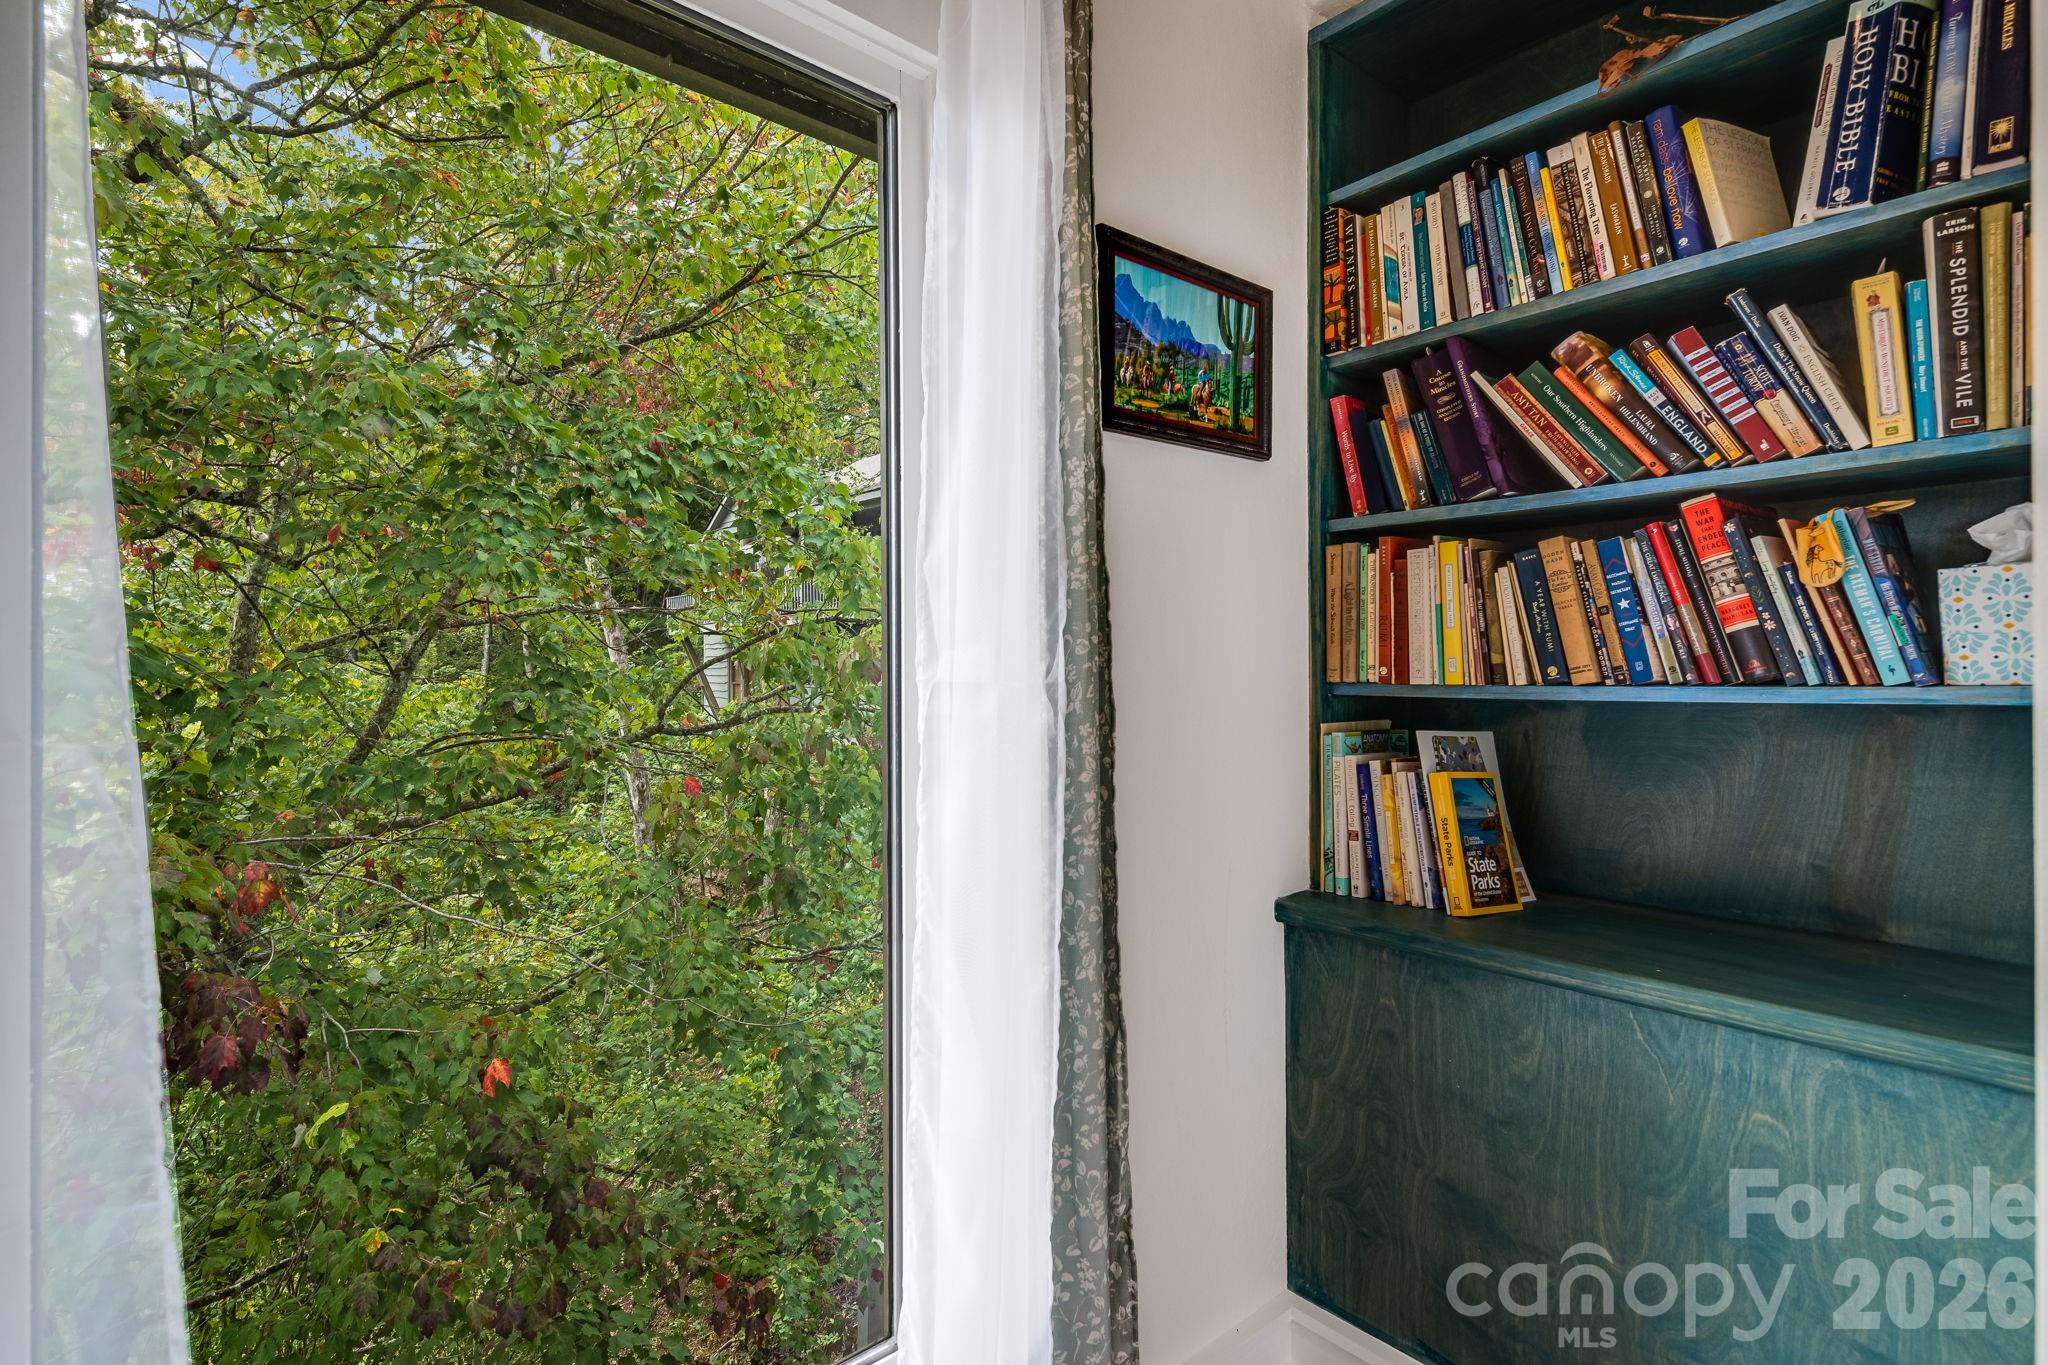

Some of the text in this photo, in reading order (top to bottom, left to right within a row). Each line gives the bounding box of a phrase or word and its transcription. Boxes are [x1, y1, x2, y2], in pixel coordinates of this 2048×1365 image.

[2002, 2, 2016, 50] MIRACLES
[1834, 25, 1879, 173] HOLY BIBLE
[1594, 137, 1605, 149] THE
[1651, 118, 1672, 163] ram dass
[1628, 136, 1645, 183] SACRED SOUL
[1633, 130, 1651, 182] SACRED EARTH
[1515, 176, 1530, 211] FINDING
[1579, 165, 1602, 235] The Flowering Tree
[1661, 166, 1686, 231] be love now
[1522, 212, 1535, 238] INNER
[1536, 201, 1547, 226] SEARCH
[1607, 202, 1624, 235] EASWARAN
[1649, 203, 1662, 239] JOHN PHILIP
[1945, 216, 1968, 228] ERIK
[1367, 229, 1377, 256] BHAGAVAD
[1542, 227, 1550, 241] FOR
[1936, 223, 1976, 237] LARSON
[1343, 224, 1356, 292] WITNESS
[1399, 245, 1407, 269] TERESA
[1527, 238, 1541, 275] COURAGE
[1545, 242, 1556, 272] MEANING
[1954, 240, 1963, 253] THE
[1401, 270, 1407, 278] OF
[1370, 279, 1379, 308] EASWARAN
[1401, 280, 1409, 300] AVILA
[1948, 257, 1969, 336] SPLENDID
[1958, 340, 1966, 356] AND
[1777, 310, 1843, 413] IVAN DOIG ENGLISH CREEK
[1959, 358, 1967, 371] THE
[1428, 371, 1452, 384] Course
[1438, 380, 1446, 388] in
[1583, 363, 1624, 403] UNBROKEN
[1741, 366, 1764, 394] TUROW
[1753, 362, 1775, 388] SCOTT
[1430, 380, 1456, 396] Miracles
[1954, 372, 1973, 407] VILE
[1509, 389, 1548, 428] AMY TAN
[1542, 383, 1609, 453] Our Southern Highlanders
[1634, 408, 1657, 430] LAURA
[1518, 421, 1535, 439] GRACE
[1617, 404, 1659, 446] HILLENBRAND
[1660, 403, 1709, 455] ENGLAND
[1341, 429, 1351, 451] Words
[1346, 458, 1355, 474] Live
[1349, 474, 1357, 483] By
[1694, 508, 1711, 518] THE
[1696, 515, 1714, 526] WAR
[1674, 537, 1685, 555] TICKLE
[1698, 530, 1724, 544] ENDED
[1702, 540, 1728, 552] PEACE
[1834, 519, 1852, 551] Catherine
[1542, 550, 1564, 559] OGDEN
[1546, 556, 1563, 564] NASH
[1841, 553, 1858, 571] THE
[1344, 588, 1354, 605] Light
[1536, 587, 1544, 607] YEAR
[1640, 540, 1686, 659] THE GREAT EMERGENCE TICKLE
[1847, 571, 1876, 617] AXEMAN'S
[1540, 609, 1549, 630] WITH
[1720, 603, 1750, 616] MARGARET
[1345, 627, 1353, 645] Attic
[1378, 615, 1387, 647] RUMI
[1544, 632, 1554, 652] RUMI
[1866, 615, 1895, 661] CARNIVAL
[1333, 760, 1341, 796] PILATES
[1372, 769, 1380, 792] LIVING
[1360, 793, 1373, 859] Three Simple Lines
[1411, 793, 1419, 826] COMFORTABLE
[1417, 840, 1427, 873] UNCERTAINTY
[1440, 817, 1455, 866] State Parks
[1468, 857, 1497, 873] State
[1470, 872, 1501, 890] Parks
